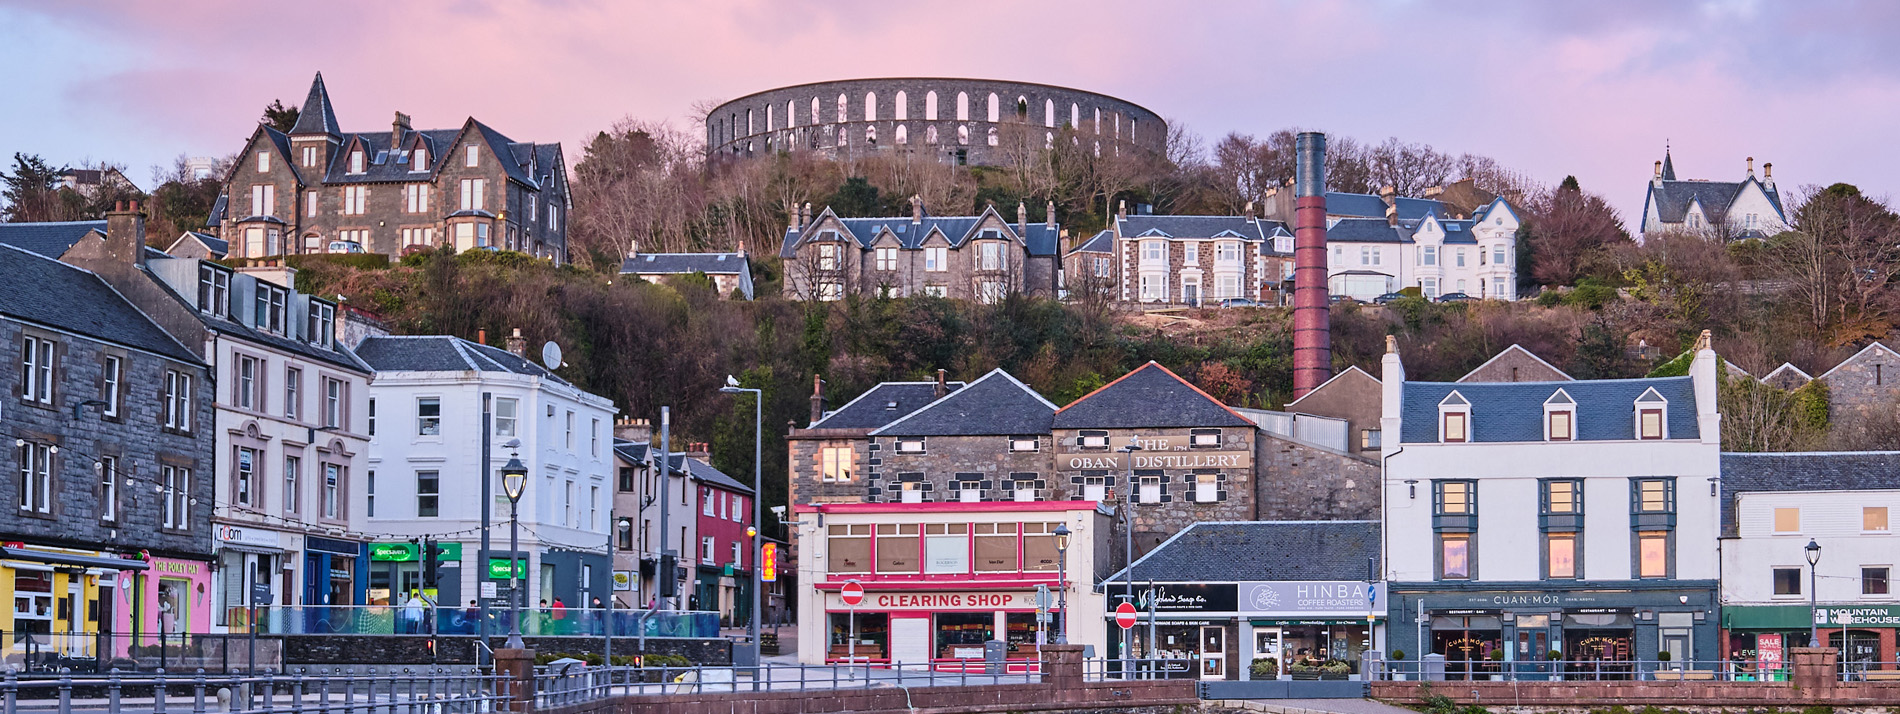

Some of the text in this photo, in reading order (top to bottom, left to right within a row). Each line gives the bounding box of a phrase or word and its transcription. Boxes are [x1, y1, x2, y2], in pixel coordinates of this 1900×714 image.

[1137, 439, 1169, 451] THE
[1069, 454, 1241, 469] OBAN DISTILLERY
[154, 561, 199, 574] THE POKEY HAT
[1297, 584, 1364, 598] HINBA
[878, 595, 961, 607] CLEARING
[967, 594, 1013, 606] SHOP
[1830, 608, 1889, 616] MOUNTAIN
[1830, 616, 1900, 624] WREHOUSE
